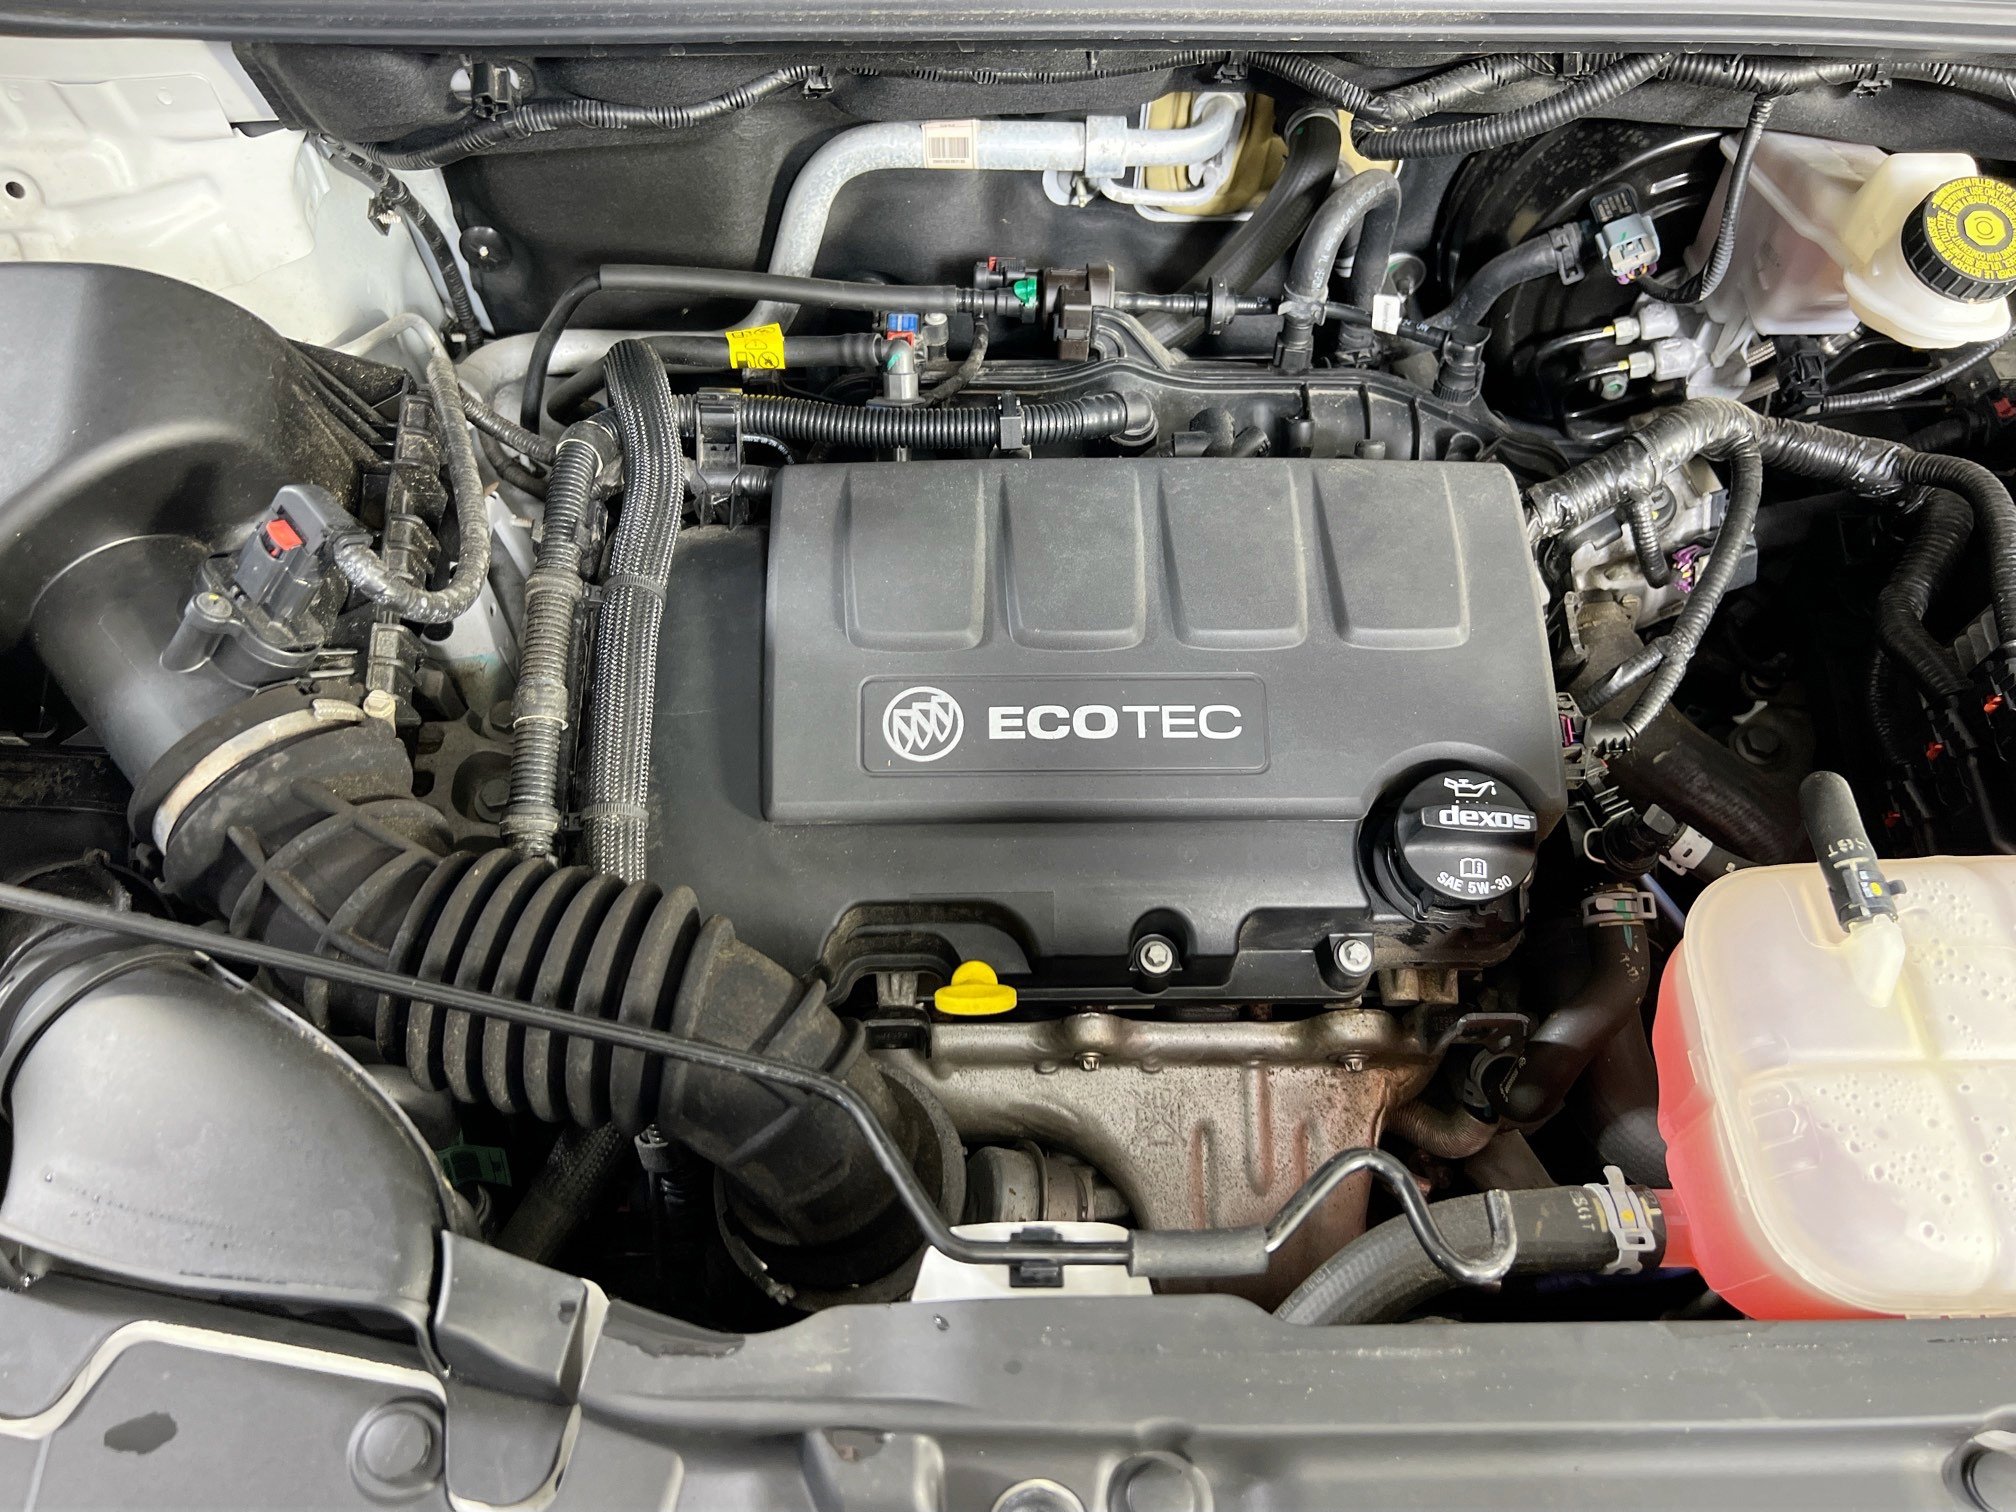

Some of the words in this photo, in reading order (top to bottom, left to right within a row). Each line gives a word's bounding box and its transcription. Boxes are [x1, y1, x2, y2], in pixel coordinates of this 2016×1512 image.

[1970, 177, 1995, 189] FILLER
[1995, 181, 2014, 196] CAP
[1940, 248, 1954, 261] DE
[1983, 269, 1995, 280] LE
[988, 704, 1243, 740] ECOTEC
[1438, 804, 1532, 830] dexos
[1436, 871, 1464, 892] SAE
[1467, 874, 1513, 895] 5W-30
